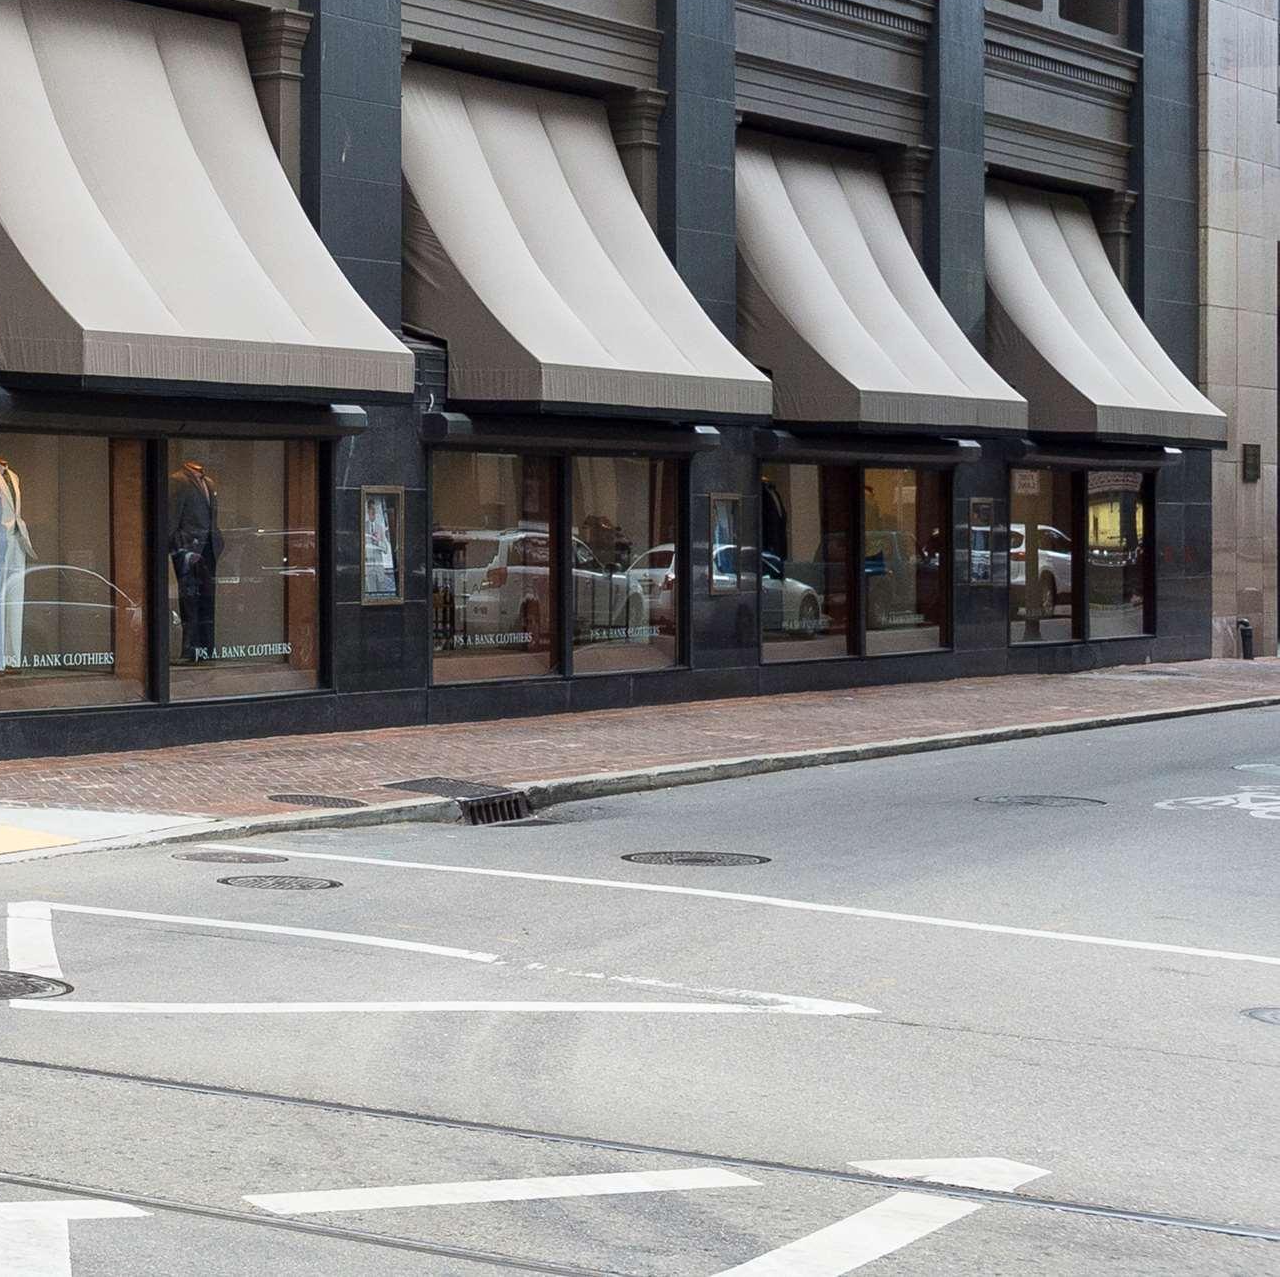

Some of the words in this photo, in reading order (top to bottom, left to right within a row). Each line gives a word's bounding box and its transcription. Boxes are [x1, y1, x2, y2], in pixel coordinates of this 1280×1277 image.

[475, 634, 495, 646] BANK
[495, 632, 533, 644] CLOTHIERS
[221, 644, 246, 658] BANK
[247, 642, 292, 657] CLOTHIERS
[33, 653, 61, 667] BANK
[63, 652, 115, 666] CLOTHIERS
